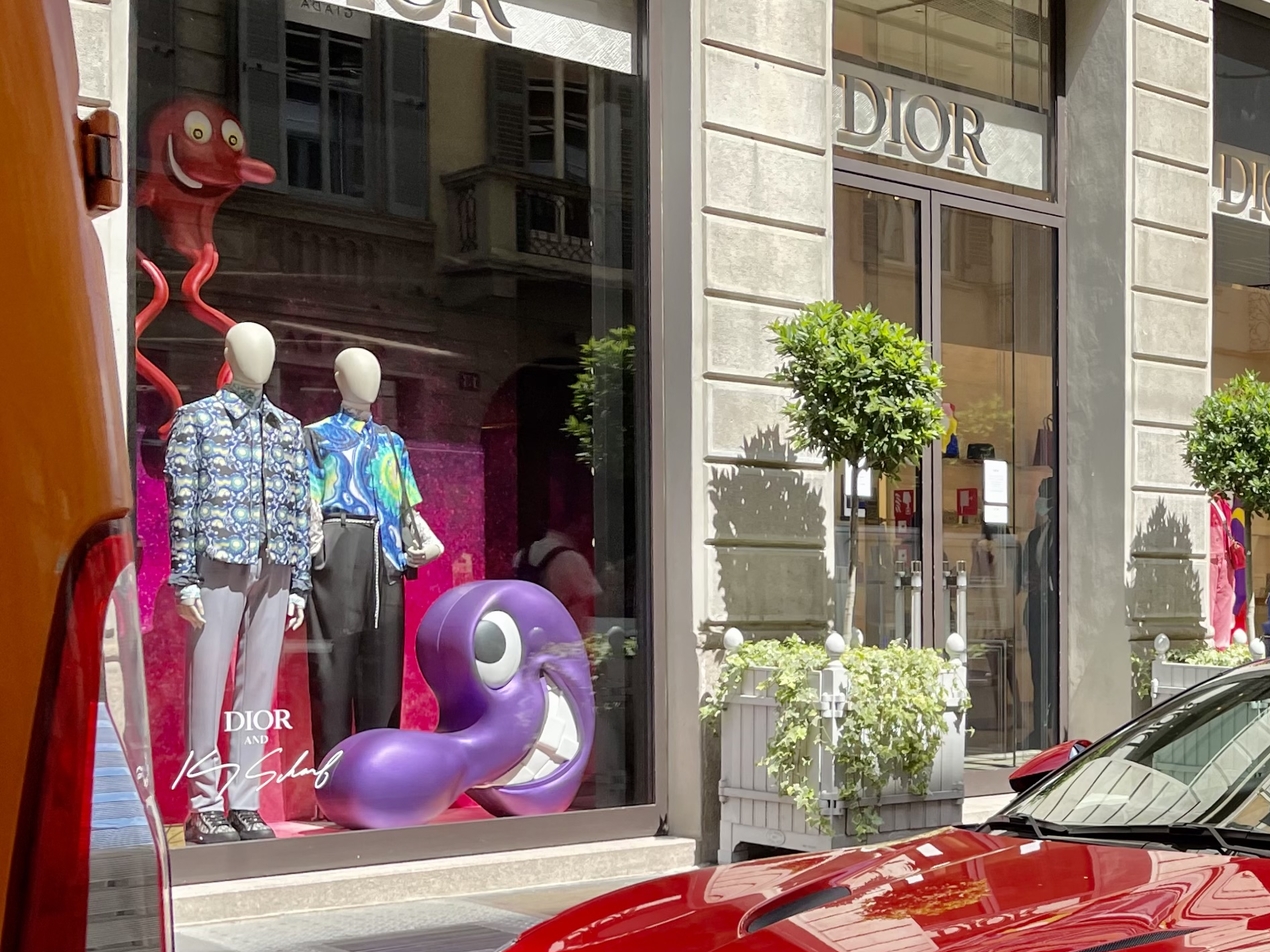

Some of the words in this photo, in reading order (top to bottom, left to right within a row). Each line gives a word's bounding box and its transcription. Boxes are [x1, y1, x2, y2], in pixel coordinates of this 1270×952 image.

[837, 74, 990, 171] DIOR
[224, 709, 293, 732] DIOR
[244, 735, 269, 745] AND
